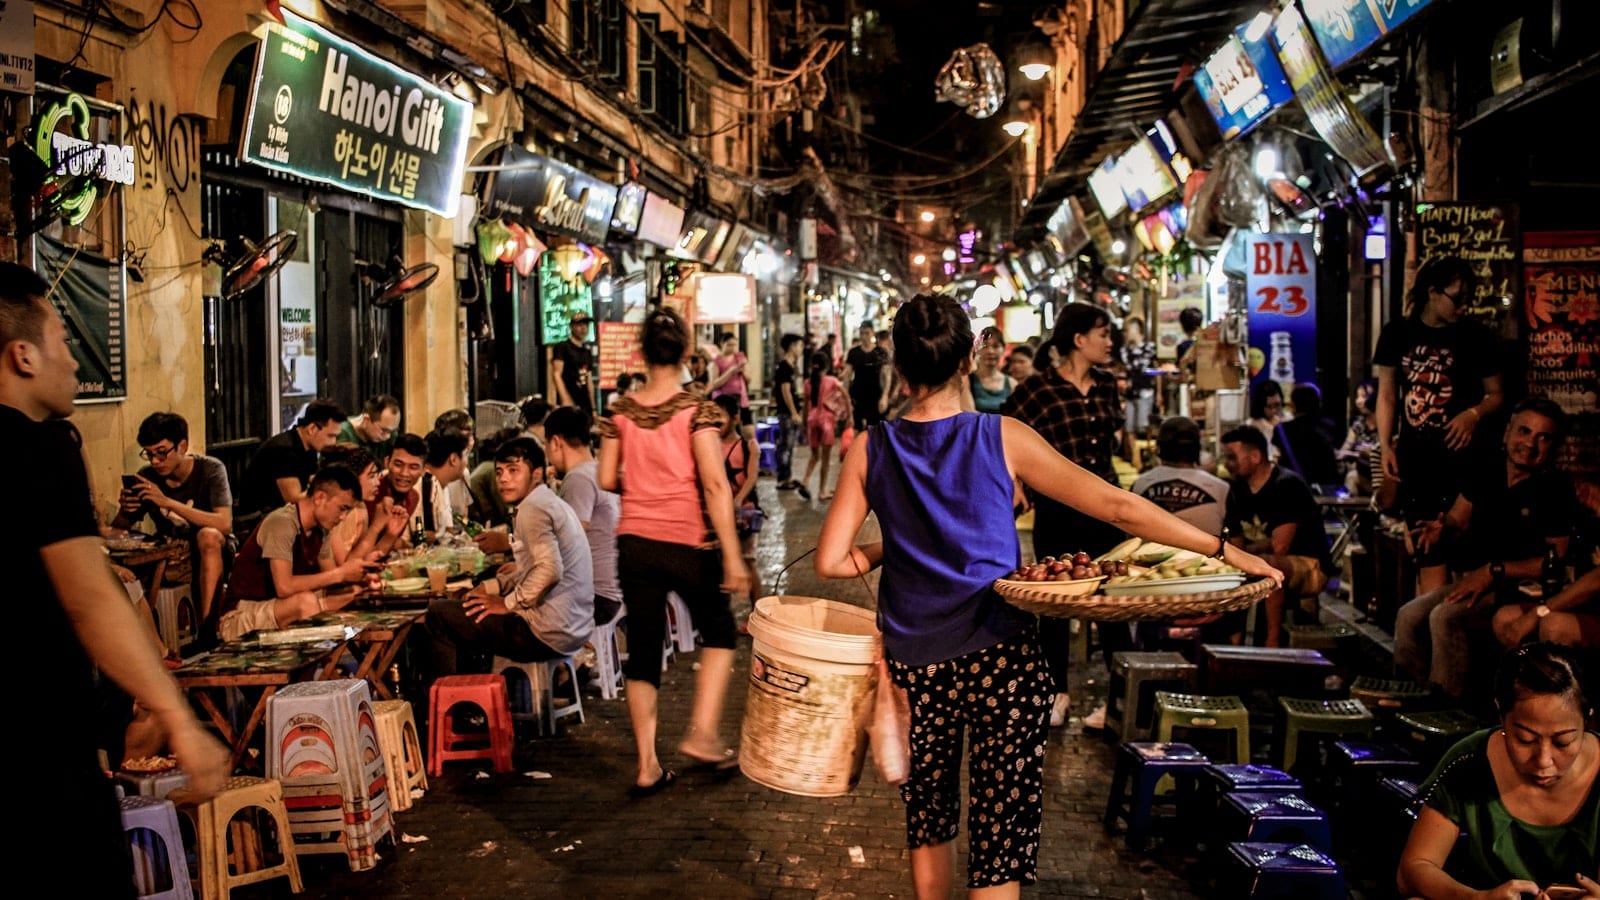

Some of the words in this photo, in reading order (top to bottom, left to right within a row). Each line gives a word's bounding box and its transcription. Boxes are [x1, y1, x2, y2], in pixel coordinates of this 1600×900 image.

[319, 47, 402, 137] Hanoi
[401, 87, 445, 154] Gift
[334, 129, 388, 189] 하노이
[389, 150, 421, 199] 선물
[1422, 226, 1460, 249] Buy
[1460, 225, 1474, 244] 2
[1253, 241, 1309, 276] BIA
[282, 308, 311, 323] WELCOME
[1256, 286, 1309, 317] 23
